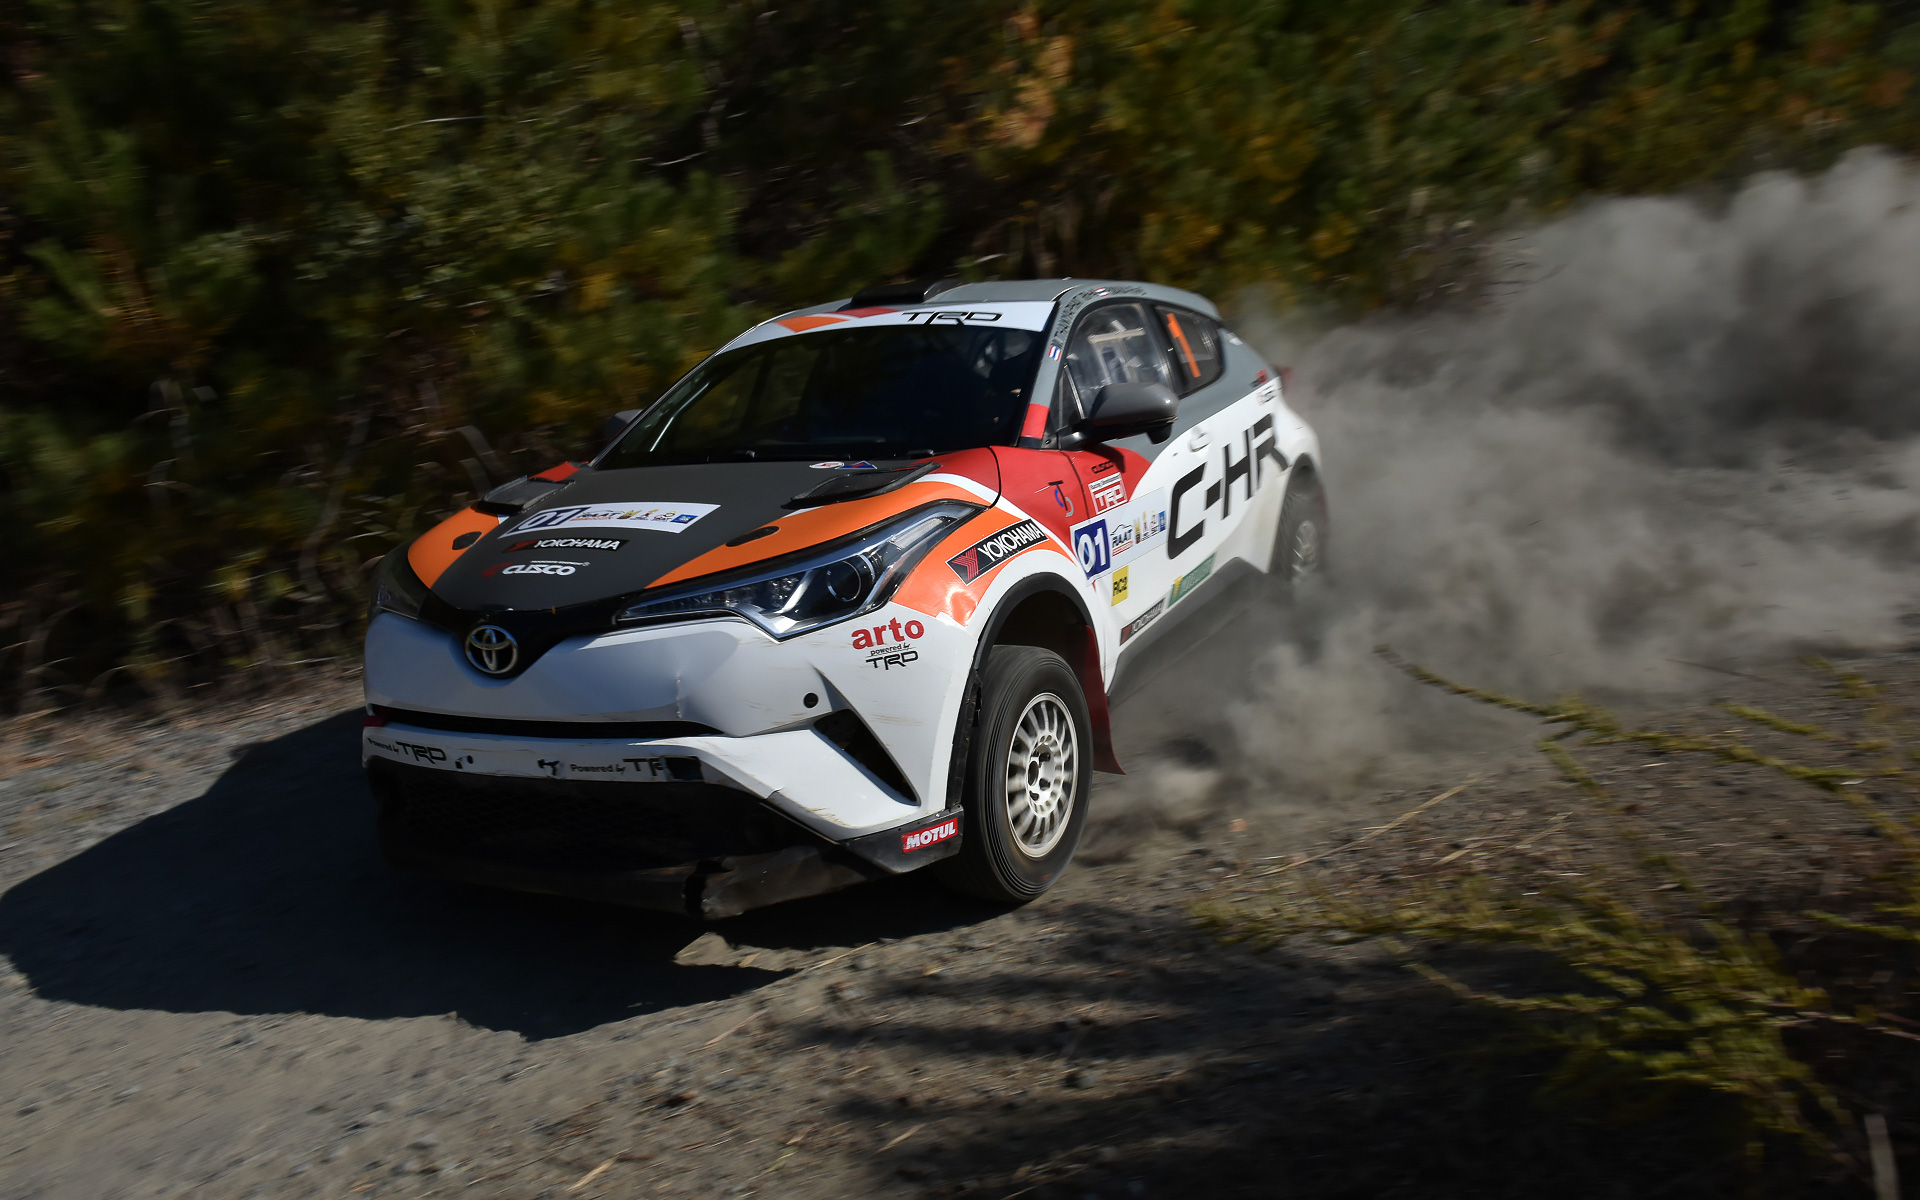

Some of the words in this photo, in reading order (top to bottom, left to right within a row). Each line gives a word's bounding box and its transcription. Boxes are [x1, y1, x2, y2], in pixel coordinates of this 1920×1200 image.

[901, 311, 1003, 326] TRD
[1167, 412, 1289, 560] C-HR
[1095, 485, 1124, 508] TRD
[518, 510, 572, 530] 01
[534, 538, 621, 551] YOKOHAMA
[977, 522, 1045, 562] YOKOHAMA
[1112, 529, 1133, 548] RAAT
[1077, 527, 1107, 573] 01
[502, 564, 576, 576] CUSCO
[1112, 576, 1128, 596] RC2
[851, 616, 925, 650] arto
[870, 643, 902, 656] powered
[865, 650, 919, 671] TRD
[395, 740, 447, 765] TRD
[570, 763, 614, 773] Powered
[905, 821, 956, 850] MOTUL
